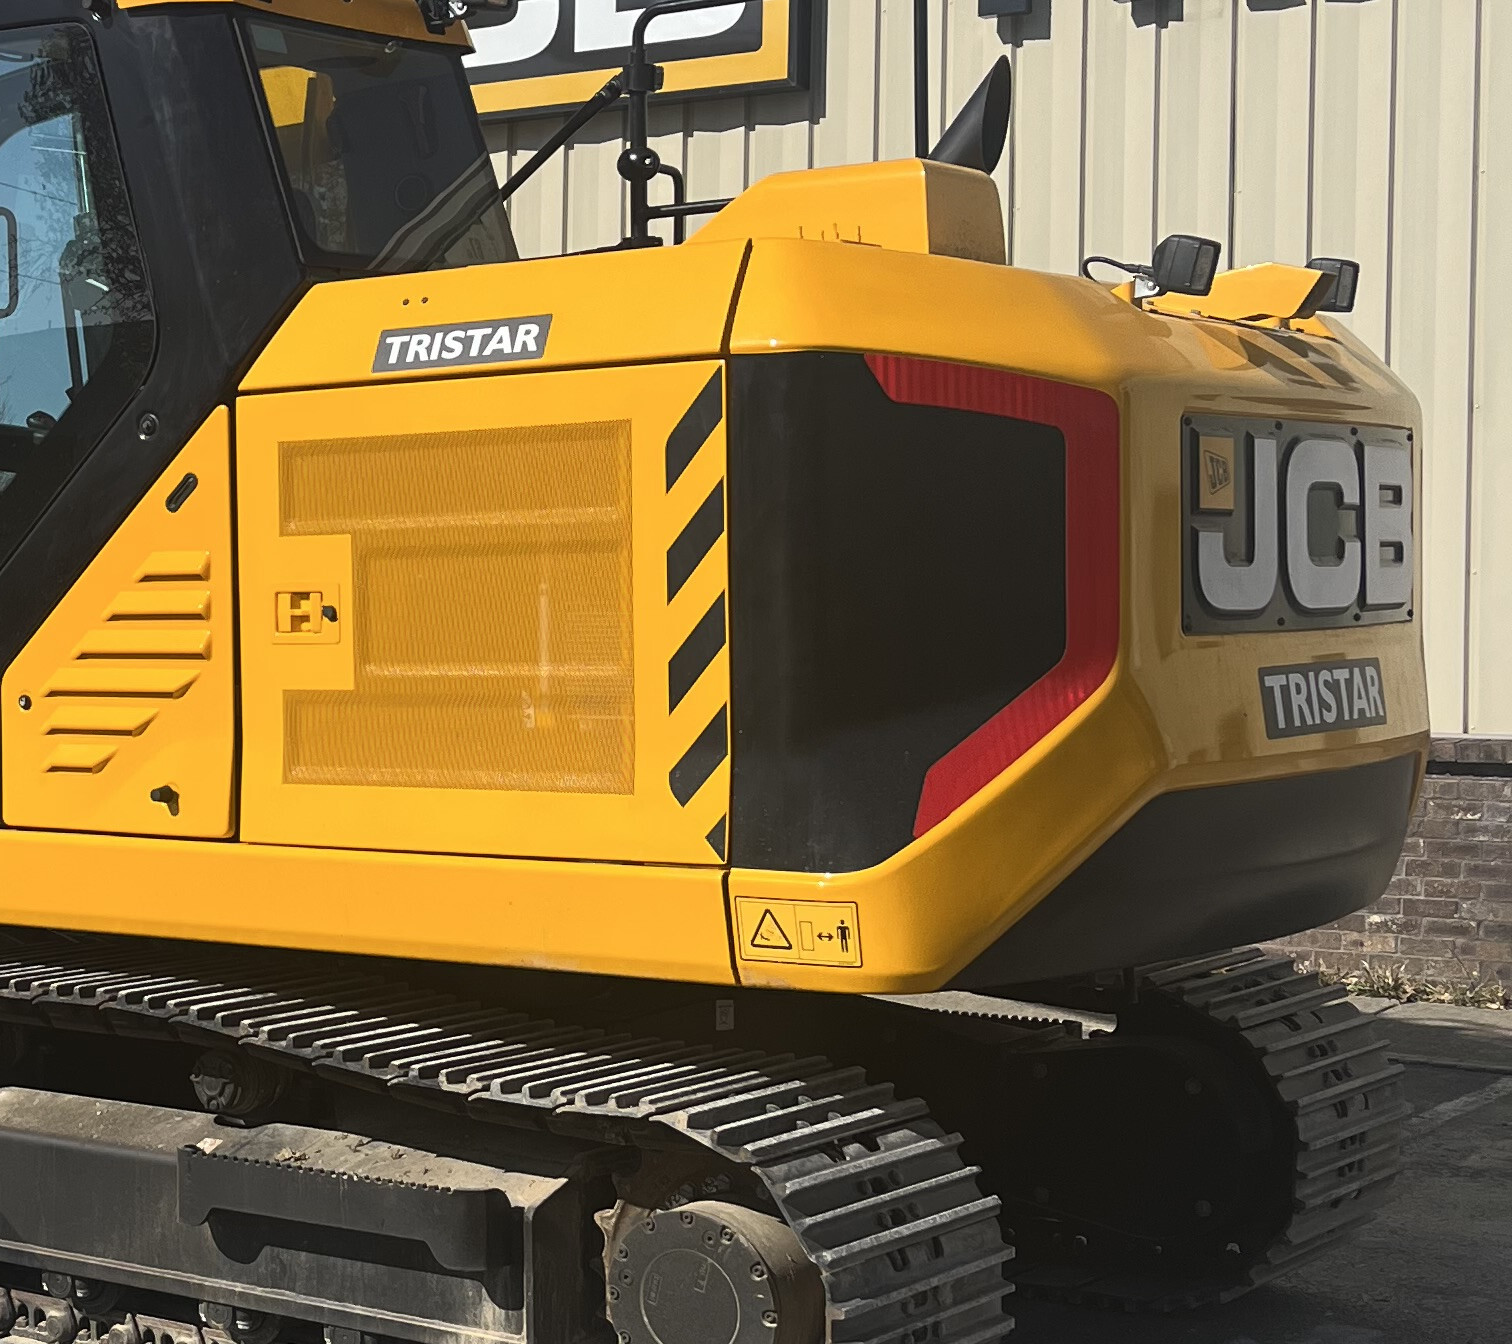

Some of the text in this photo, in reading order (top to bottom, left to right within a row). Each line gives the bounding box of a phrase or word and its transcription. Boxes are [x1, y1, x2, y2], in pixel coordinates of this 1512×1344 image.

[385, 323, 540, 365] TRISTAR
[1198, 437, 1414, 611] JCB
[1264, 665, 1384, 729] TRISTAR
